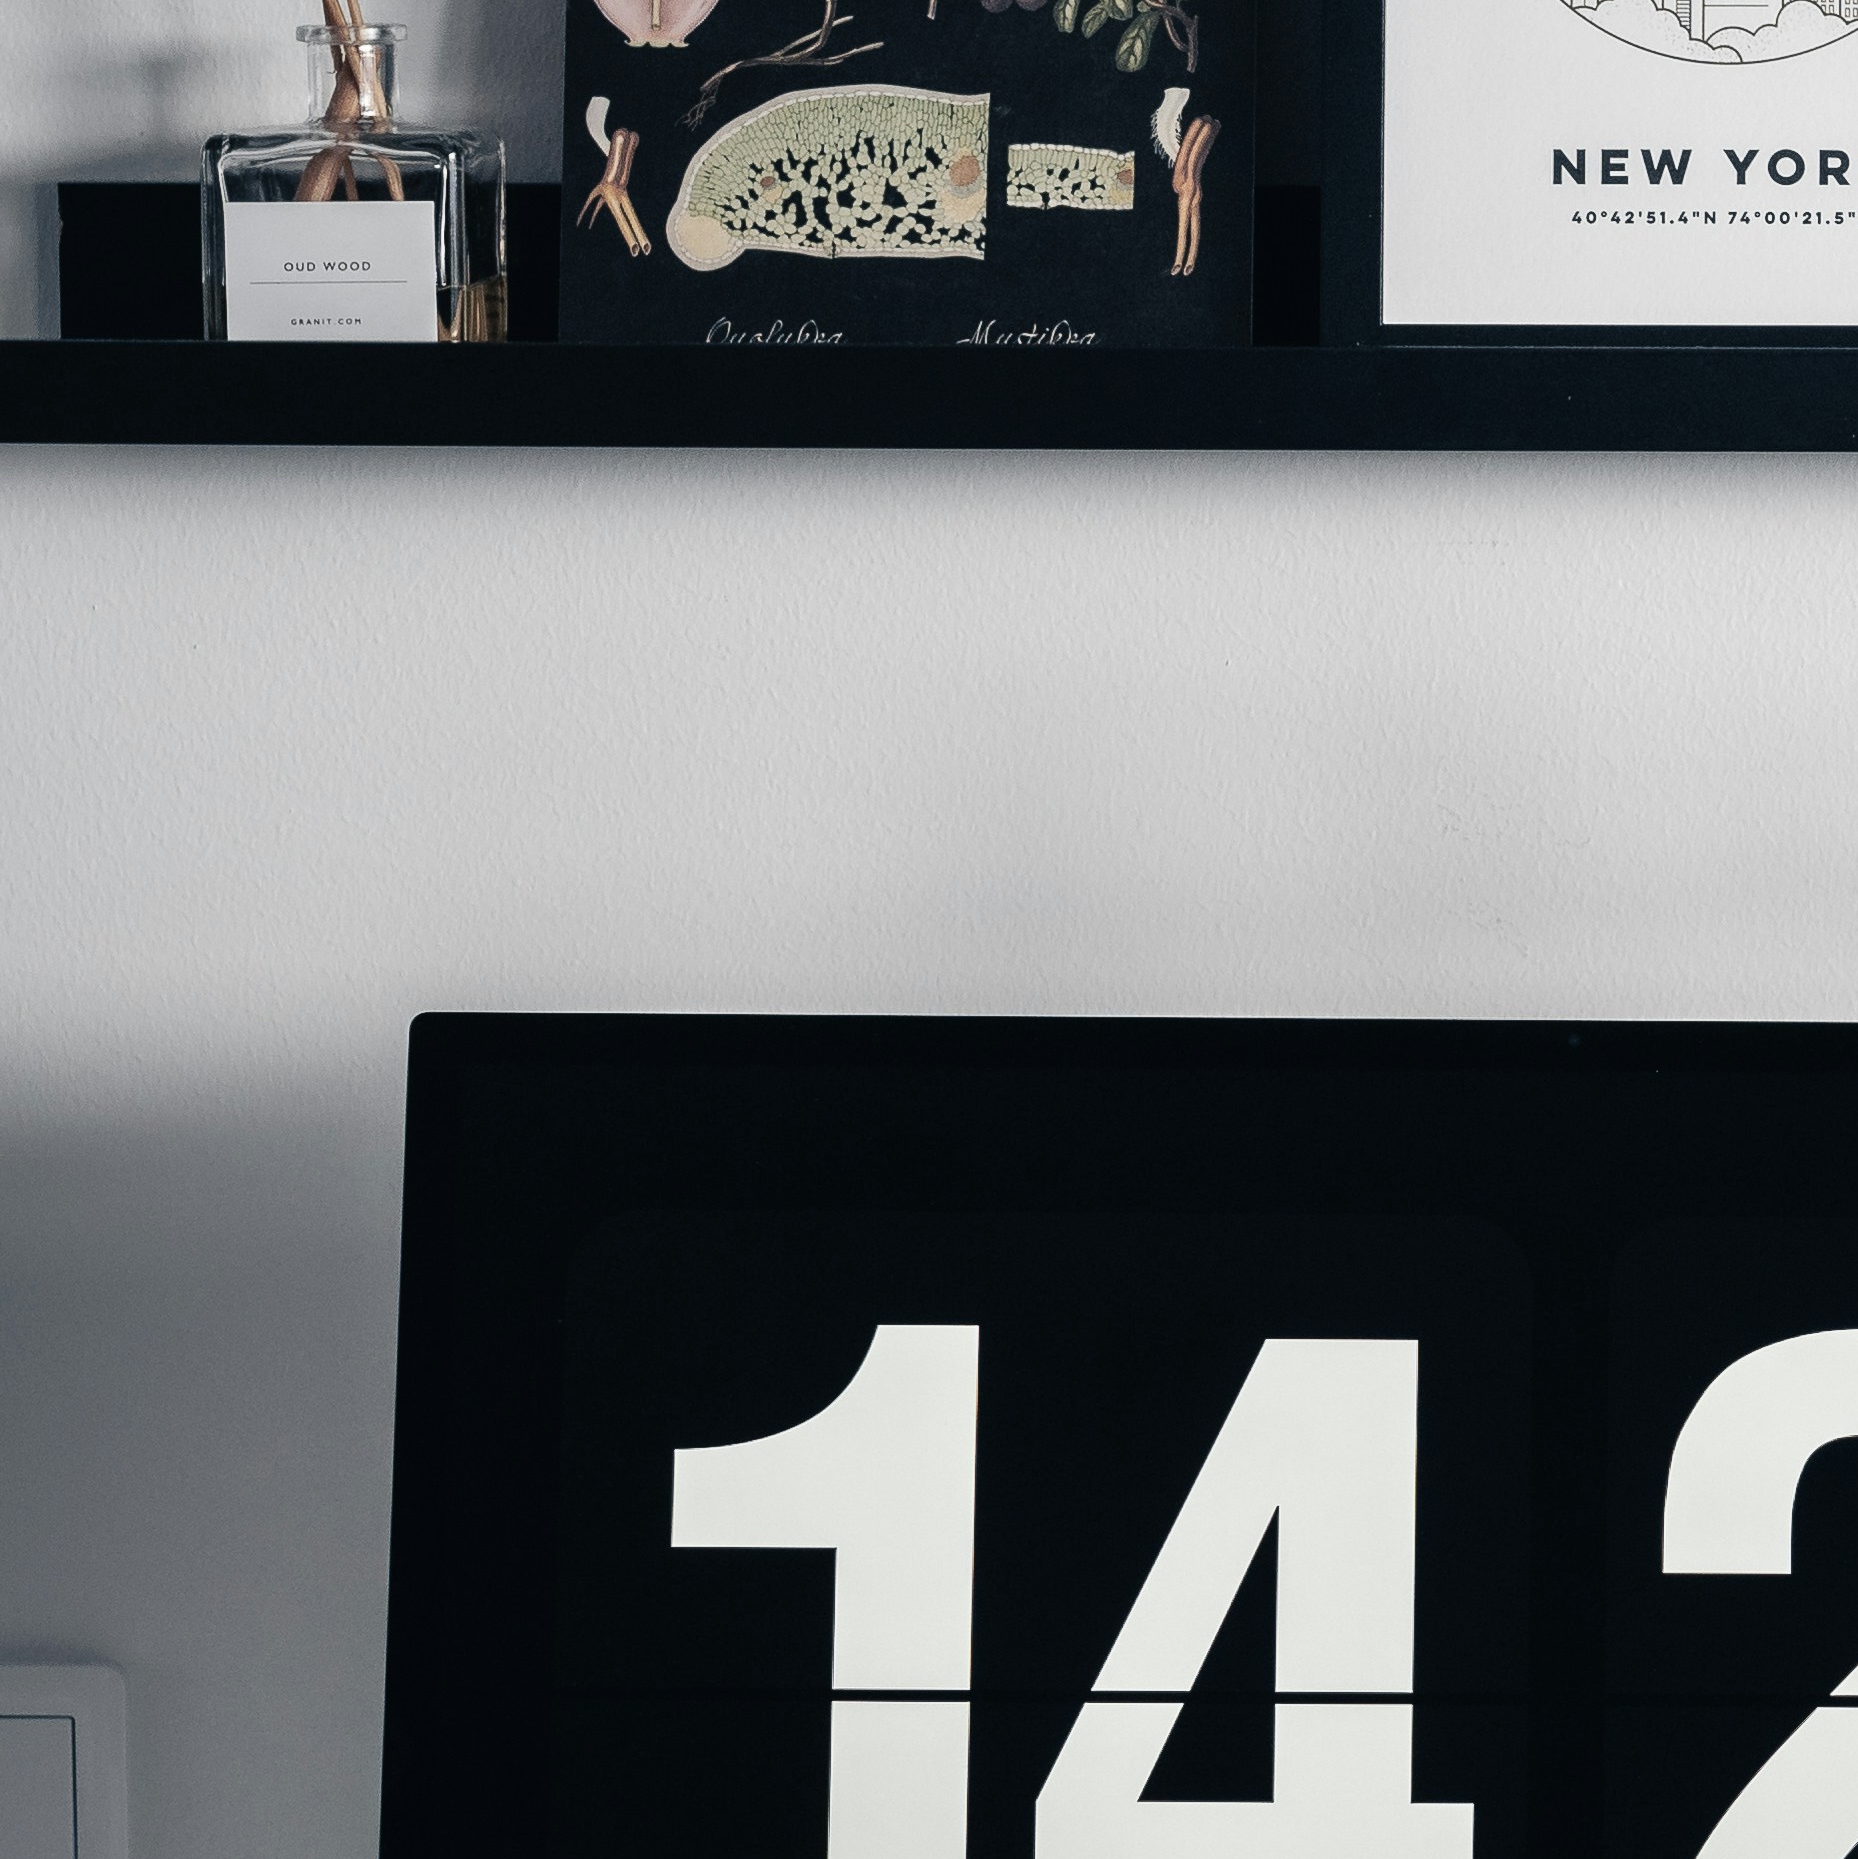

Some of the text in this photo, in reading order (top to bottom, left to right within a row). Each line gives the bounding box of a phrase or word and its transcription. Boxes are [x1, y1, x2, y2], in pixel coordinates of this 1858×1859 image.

[1552, 148, 1693, 185] NEW
[283, 261, 371, 272] OUD WOOD
